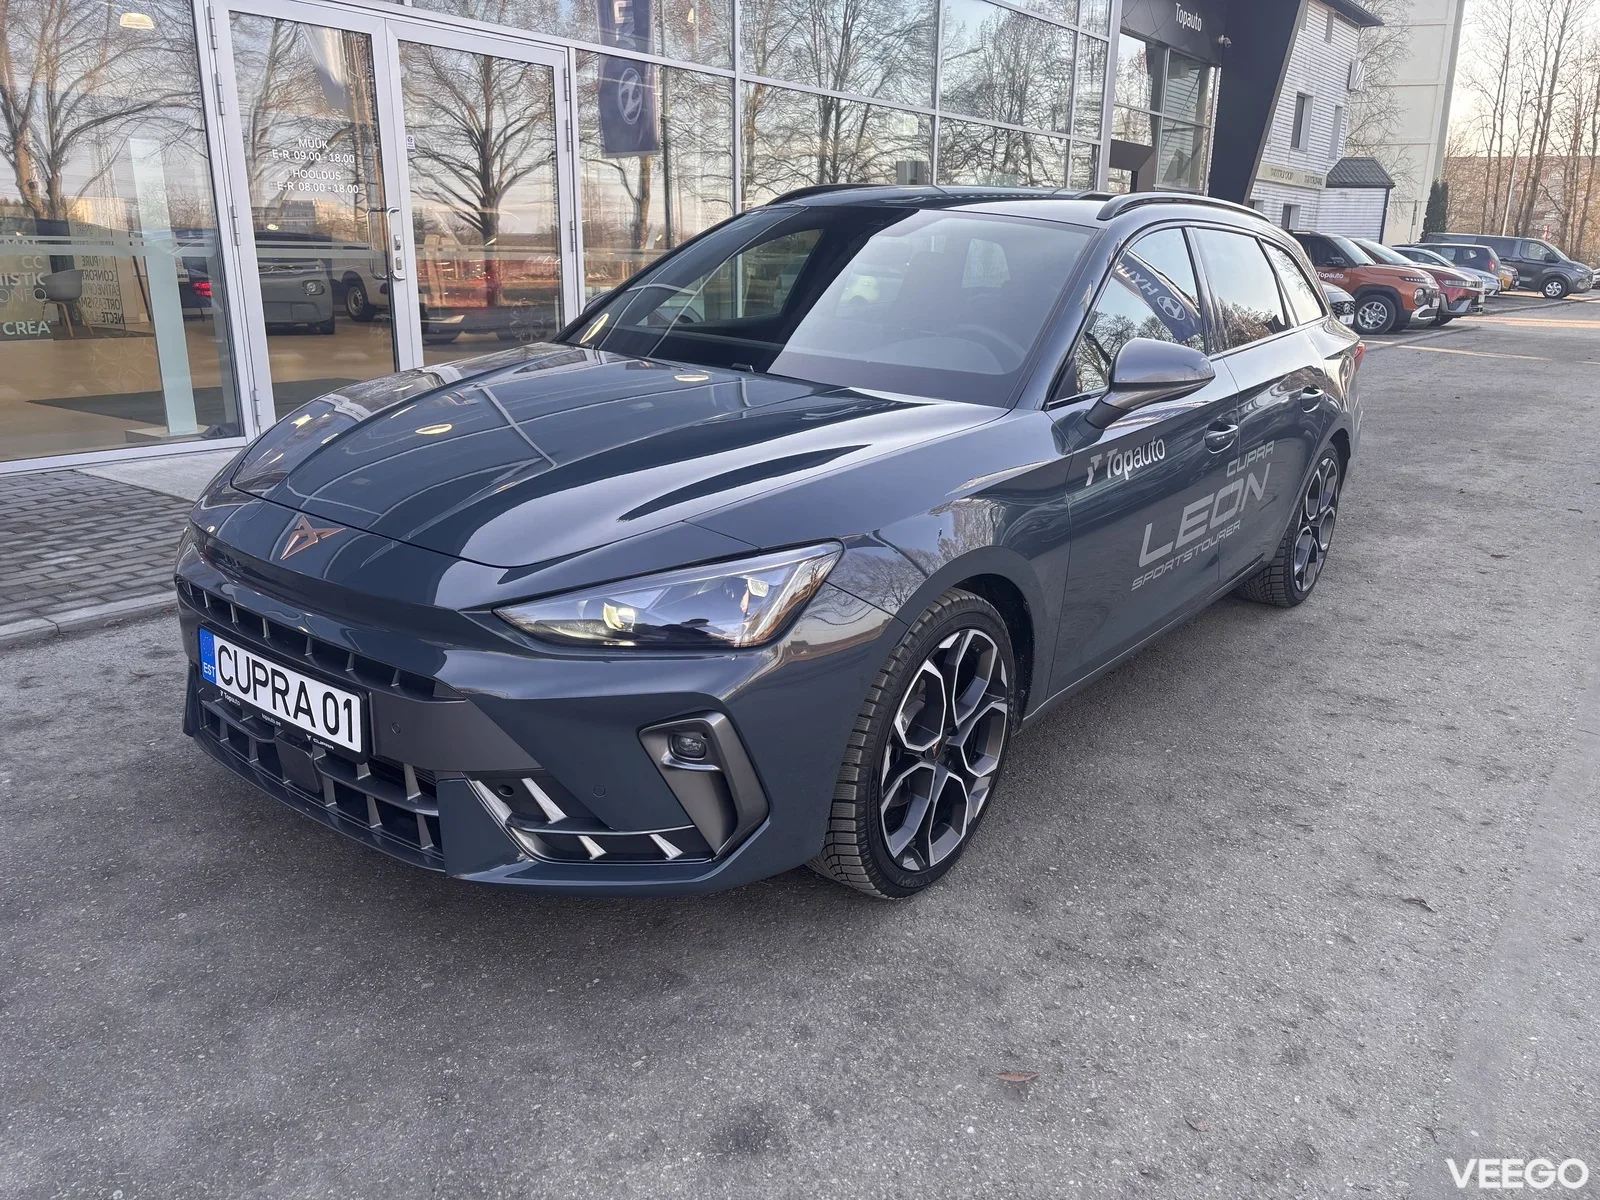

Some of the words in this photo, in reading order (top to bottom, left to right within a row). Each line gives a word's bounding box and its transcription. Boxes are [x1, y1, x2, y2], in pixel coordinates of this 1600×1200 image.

[1175, 2, 1202, 31] Topauto
[298, 138, 328, 149] MÜÜK
[272, 149, 290, 159] E-R
[293, 150, 321, 161] 09.00
[329, 153, 355, 163] 18.00
[292, 168, 341, 180] HOOLDUS
[277, 183, 294, 191] E-R
[298, 183, 325, 192] 08.00
[334, 184, 359, 194] 18.00
[1317, 271, 1344, 280] Topauto
[1106, 436, 1166, 480] Topauto
[1226, 440, 1275, 478] CUPRA
[1139, 462, 1271, 568] LEON
[1131, 519, 1241, 591] SPORTSTOURER
[203, 662, 216, 678] EST
[217, 644, 317, 729] CUPRA
[322, 691, 354, 743] 01
